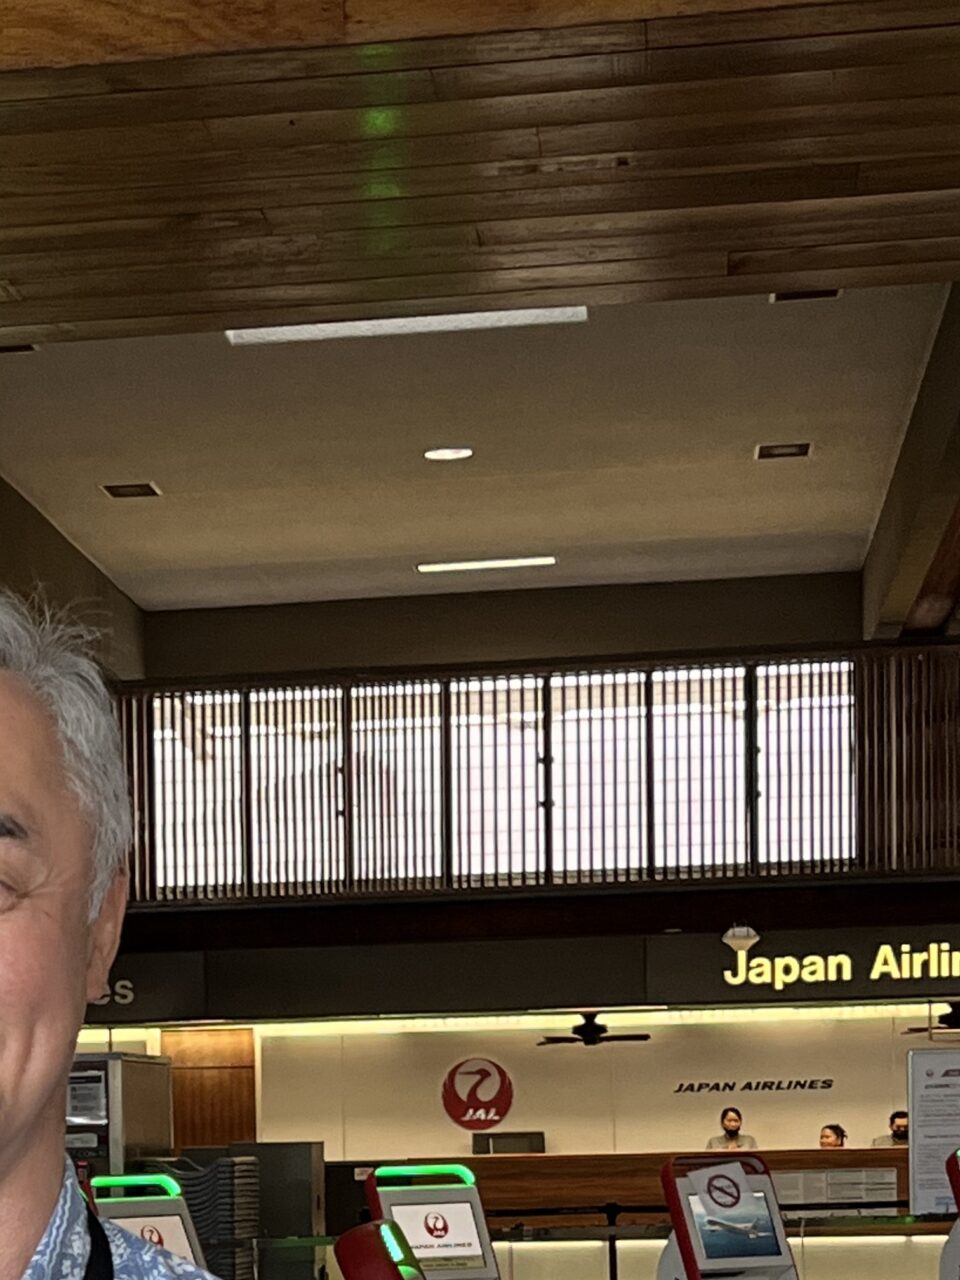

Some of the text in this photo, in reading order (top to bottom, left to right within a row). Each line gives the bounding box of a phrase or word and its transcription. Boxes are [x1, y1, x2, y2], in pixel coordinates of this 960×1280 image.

[723, 949, 852, 990] Japan
[673, 1078, 835, 1093] JAPAN AIRLINES
[461, 1108, 501, 1121] JAL
